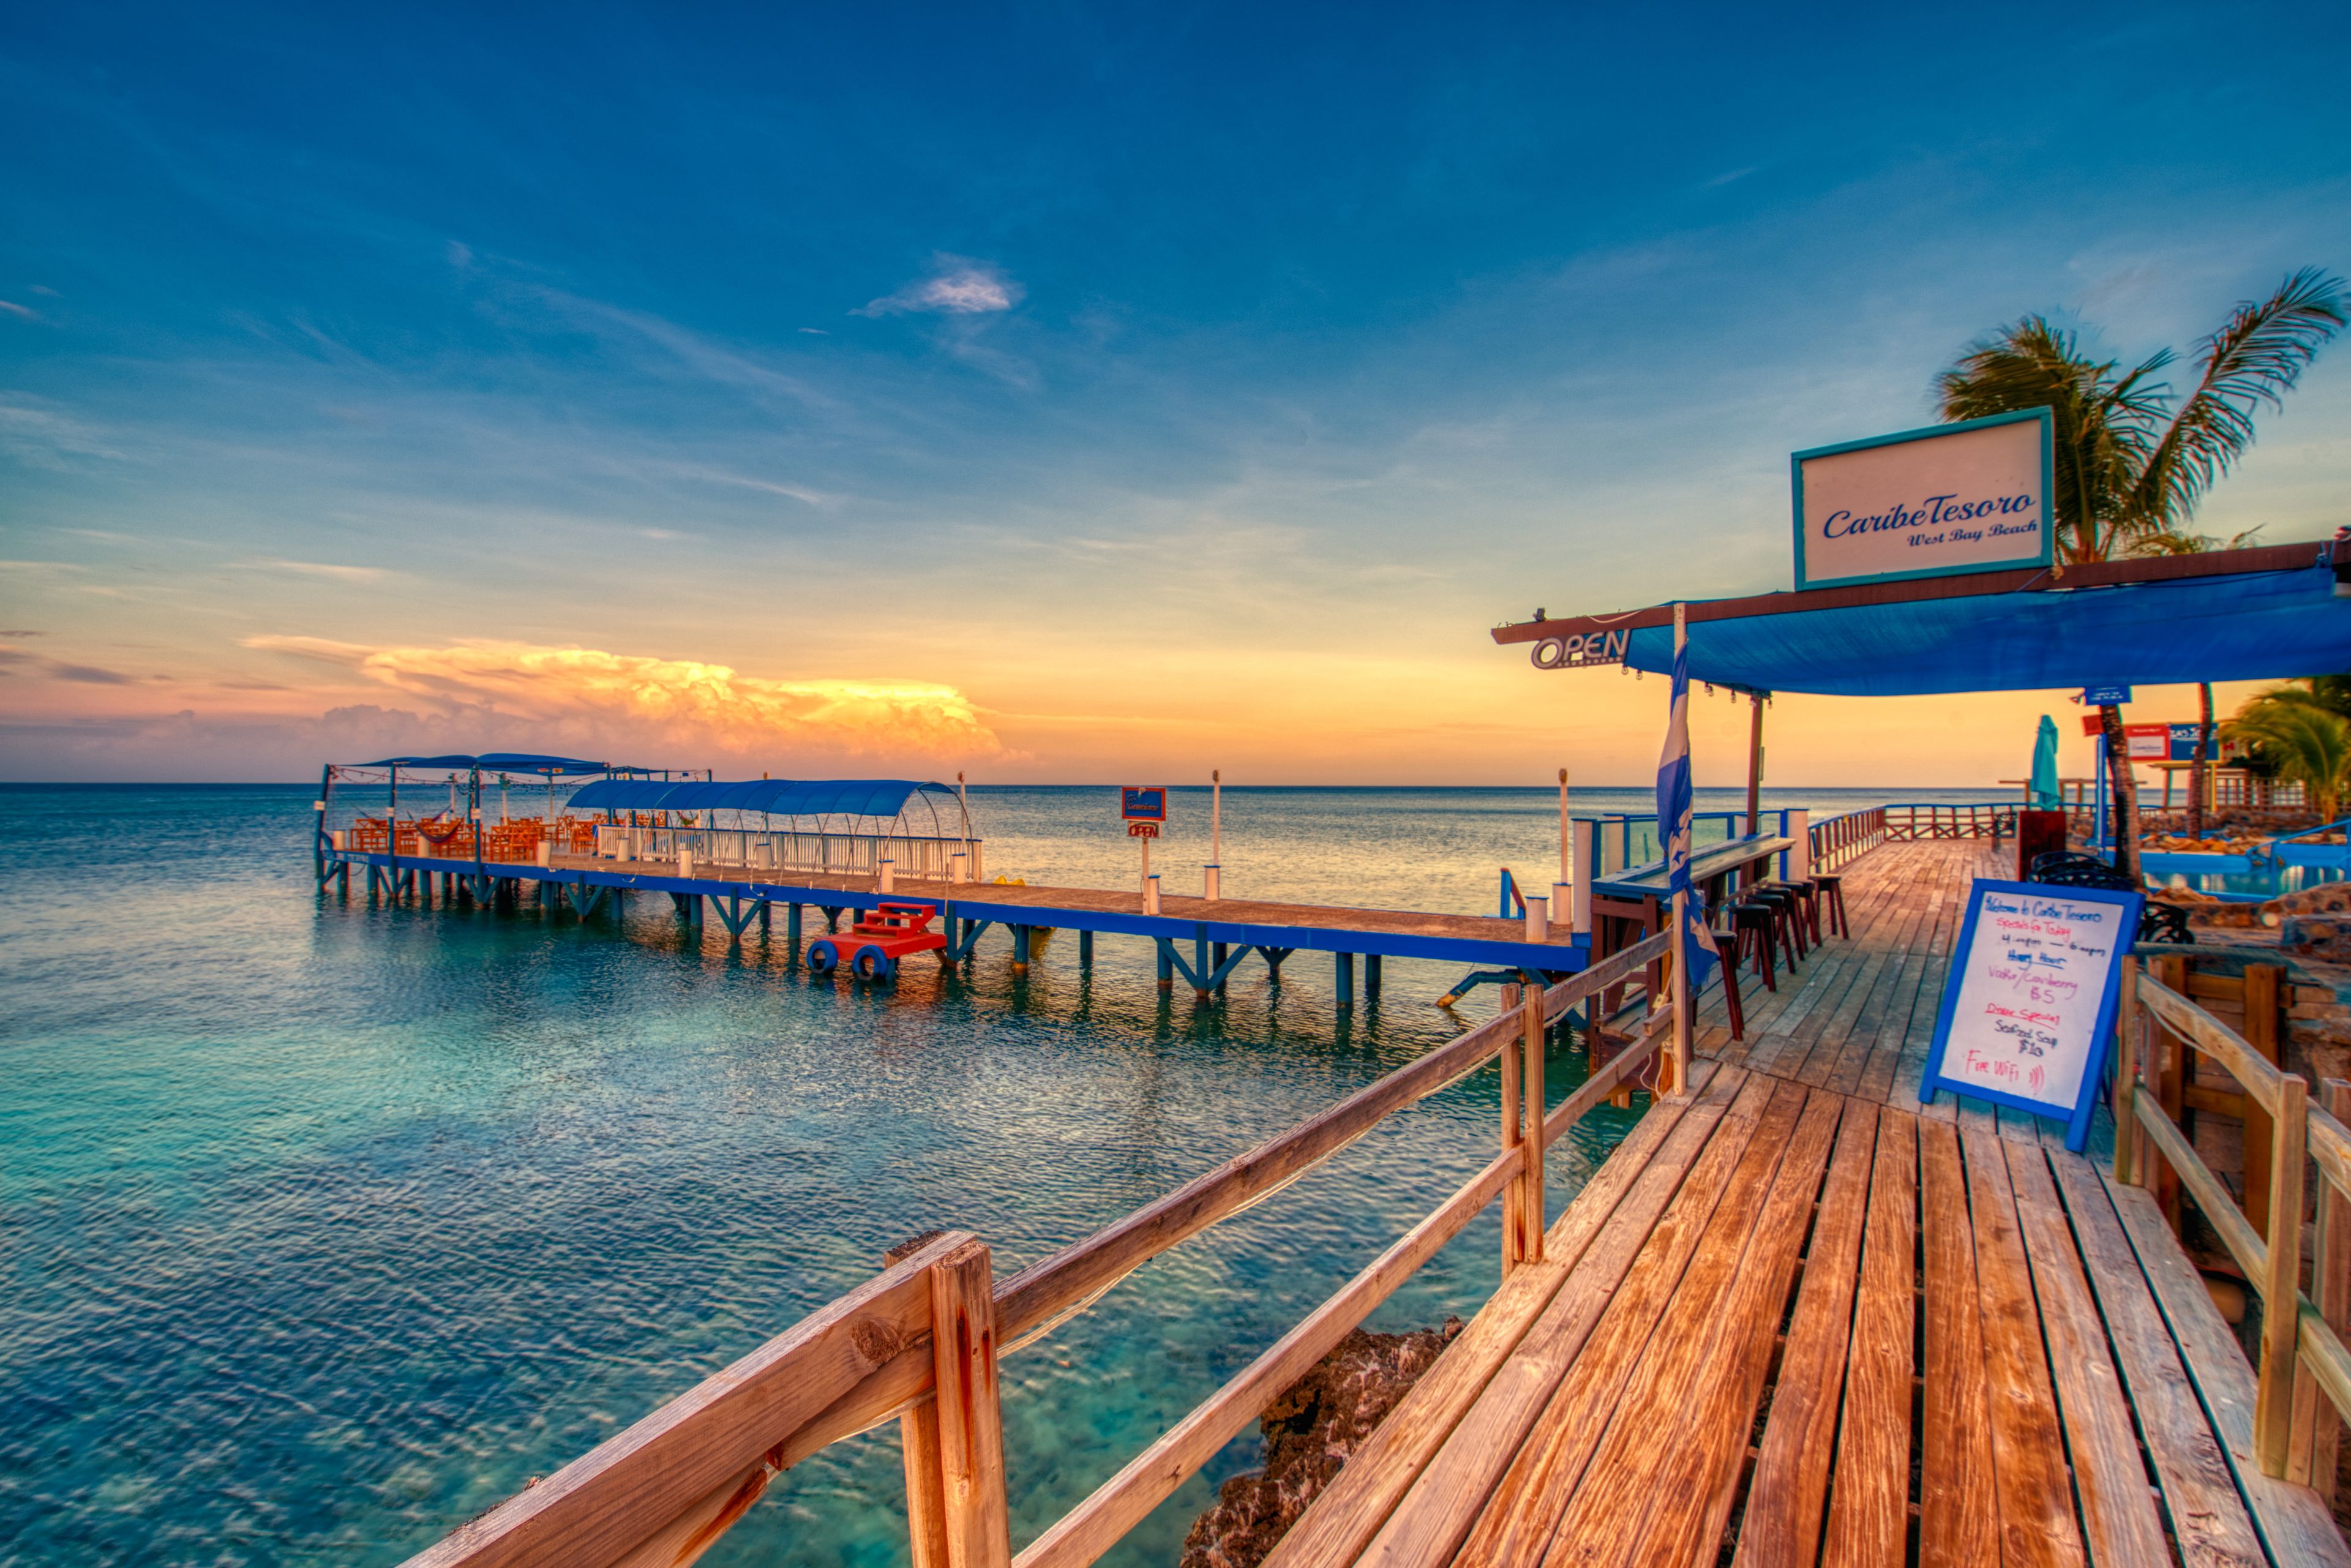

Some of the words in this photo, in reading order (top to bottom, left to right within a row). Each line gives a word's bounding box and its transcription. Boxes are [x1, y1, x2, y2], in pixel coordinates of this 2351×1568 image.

[1907, 531, 1945, 547] West
[1949, 528, 1983, 543] Bay
[1987, 519, 2038, 538] Beach
[1531, 629, 1630, 669] OPEN
[1129, 824, 1158, 838] OPEN
